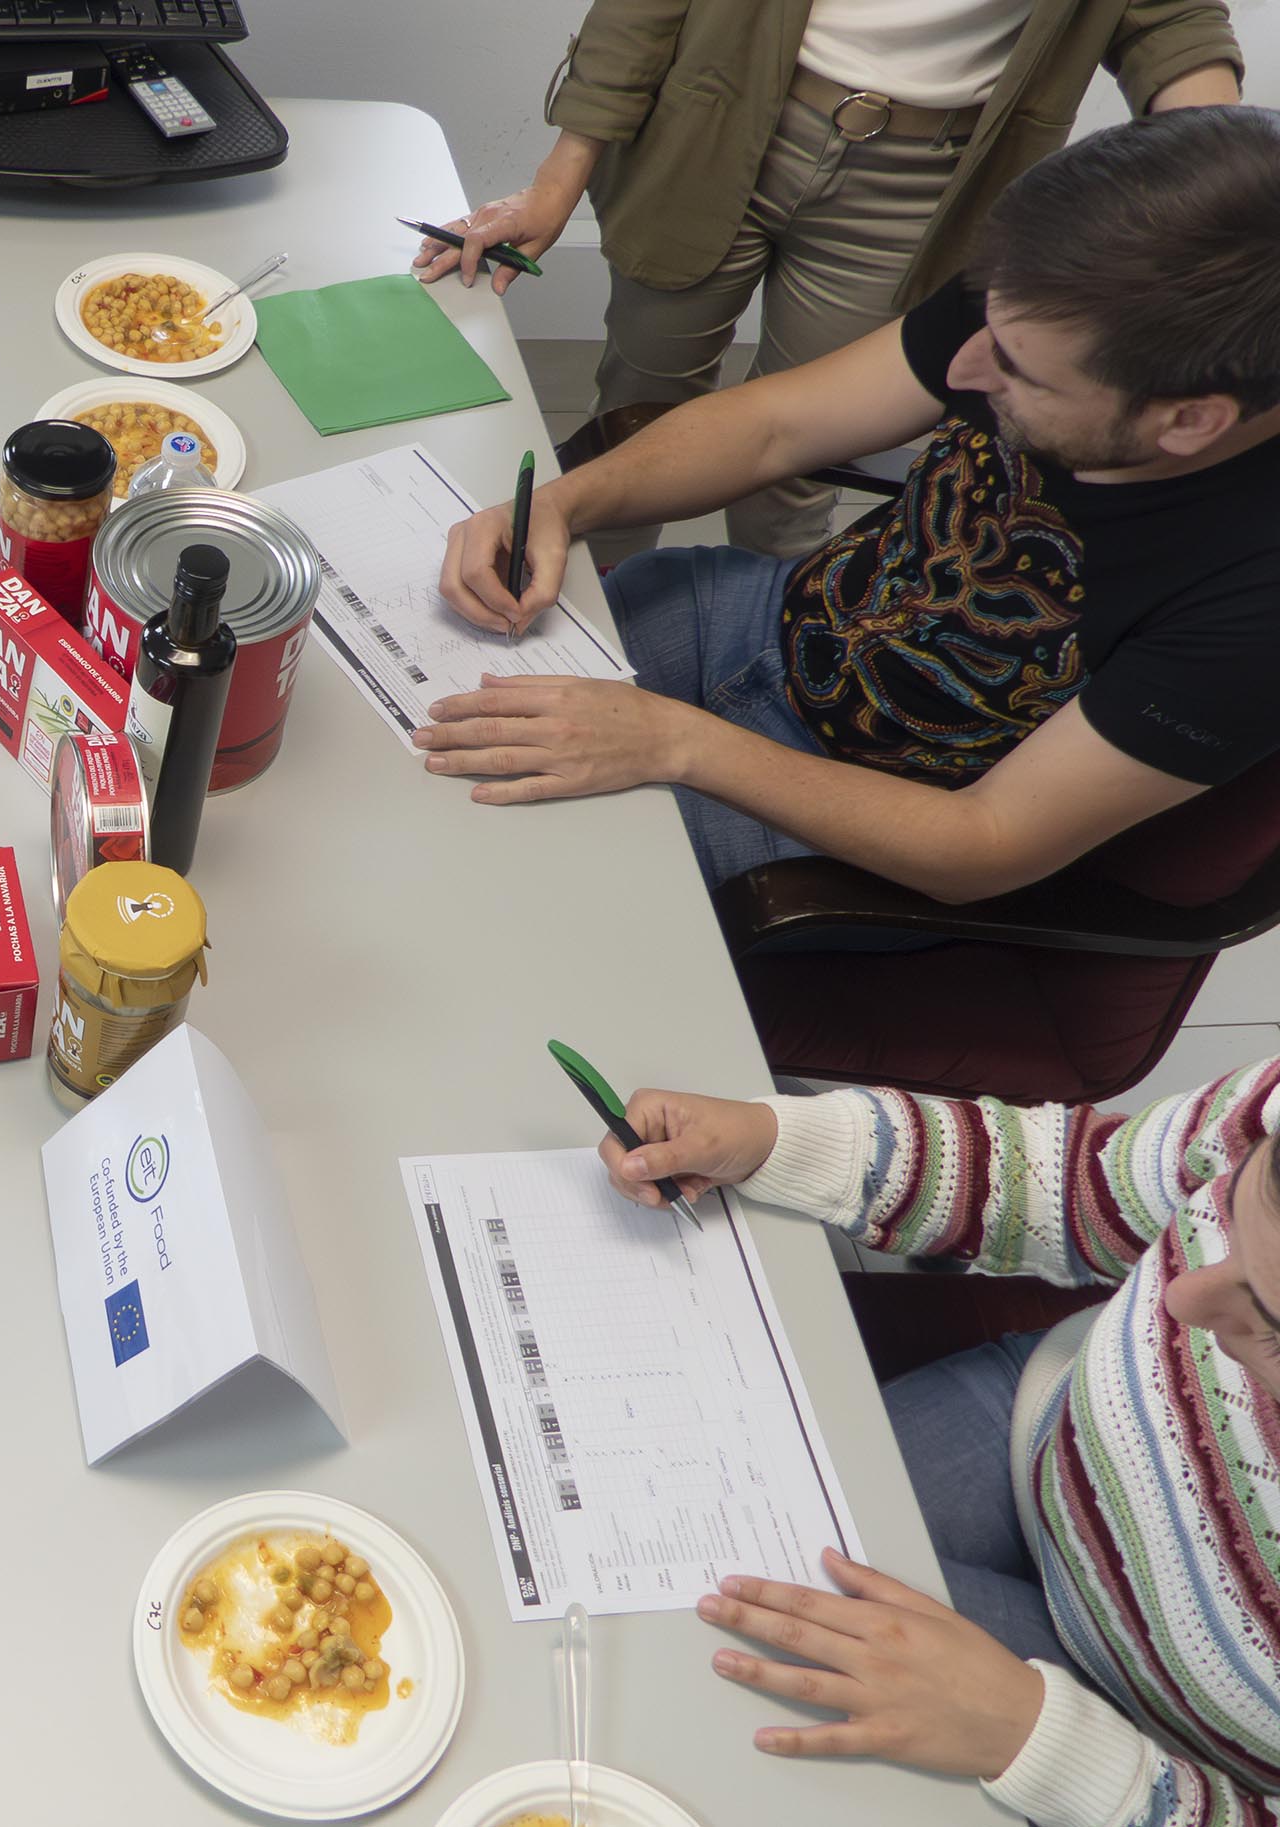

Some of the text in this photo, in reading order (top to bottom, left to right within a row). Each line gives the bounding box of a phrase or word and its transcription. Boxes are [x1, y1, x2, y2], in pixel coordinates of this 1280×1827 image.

[1, 576, 47, 617] DAN
[87, 586, 131, 659] AN
[58, 638, 92, 670] ESPÁRRAGO
[88, 668, 100, 679] DE
[96, 677, 124, 704] NAVARRA
[5, 906, 14, 917] LA
[8, 926, 23, 961] POCHAS
[139, 1147, 157, 1186] eit
[90, 1173, 115, 1286] European Union
[100, 1157, 128, 1276] Co-funded by the
[150, 1205, 172, 1271] Food
[492, 1463, 509, 1498] sensorial
[502, 1499, 516, 1529] Análisis
[519, 1577, 529, 1598] DAN
[526, 1580, 535, 1597] TZA
